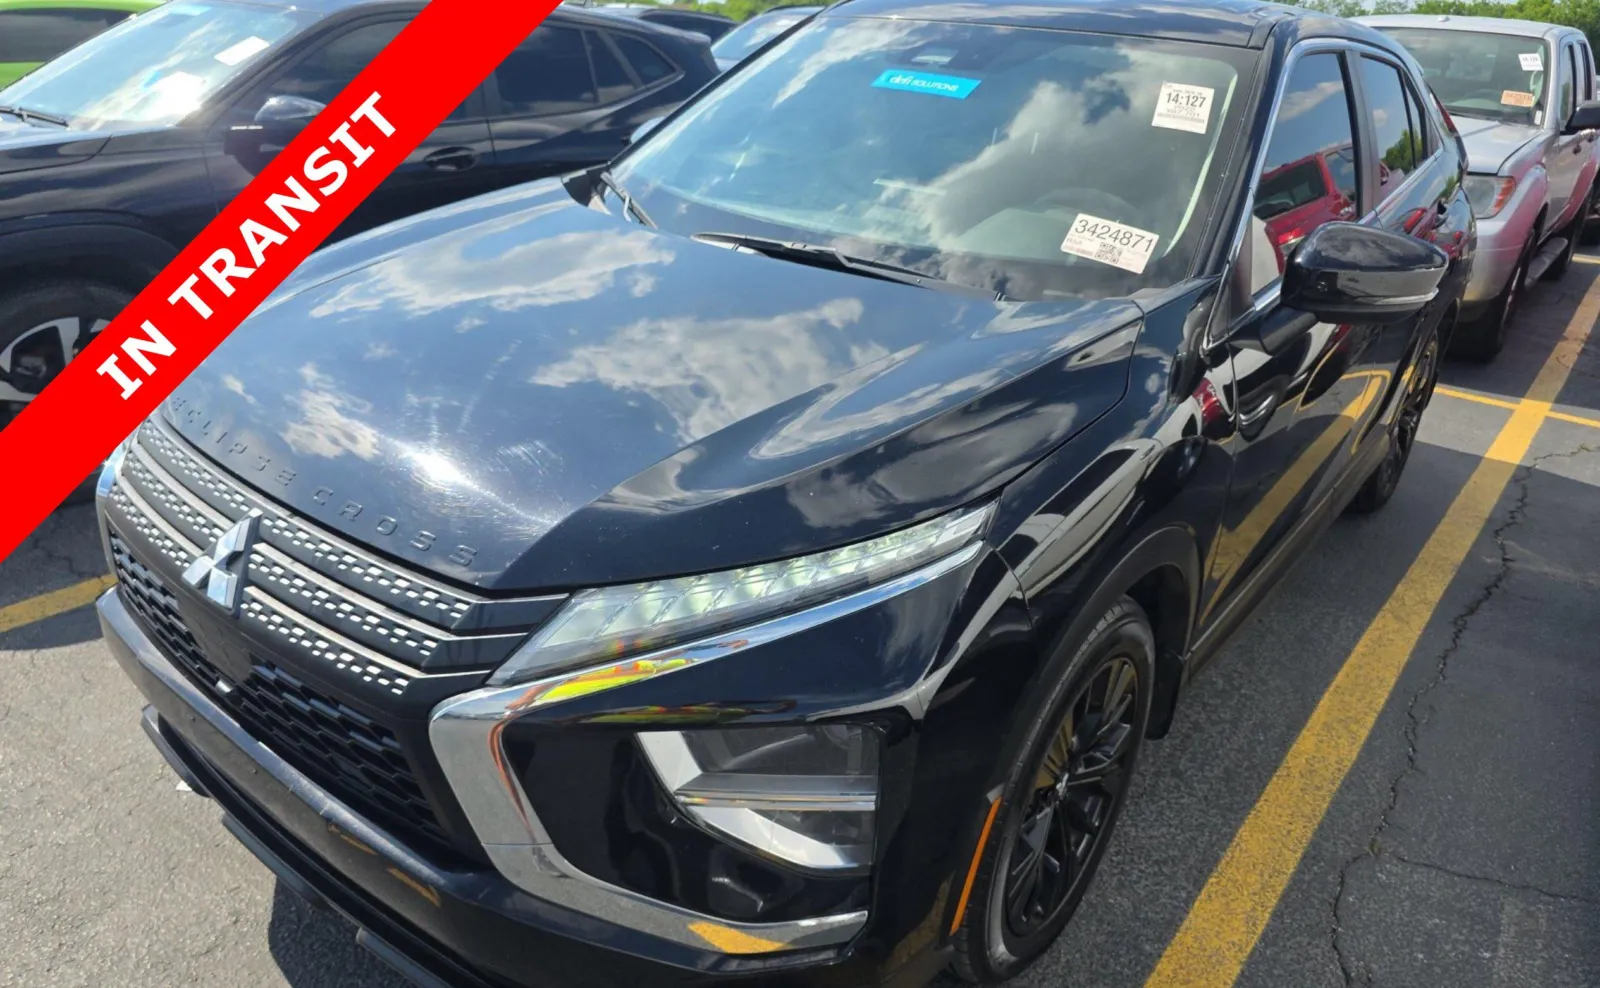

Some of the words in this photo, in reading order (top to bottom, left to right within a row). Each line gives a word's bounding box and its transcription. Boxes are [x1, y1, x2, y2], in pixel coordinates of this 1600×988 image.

[889, 74, 914, 87] defi
[1166, 92, 1207, 109] 14:127
[1075, 218, 1154, 253] 3424871
[171, 397, 298, 486] ECLIPSE
[313, 486, 478, 567] CROSS
